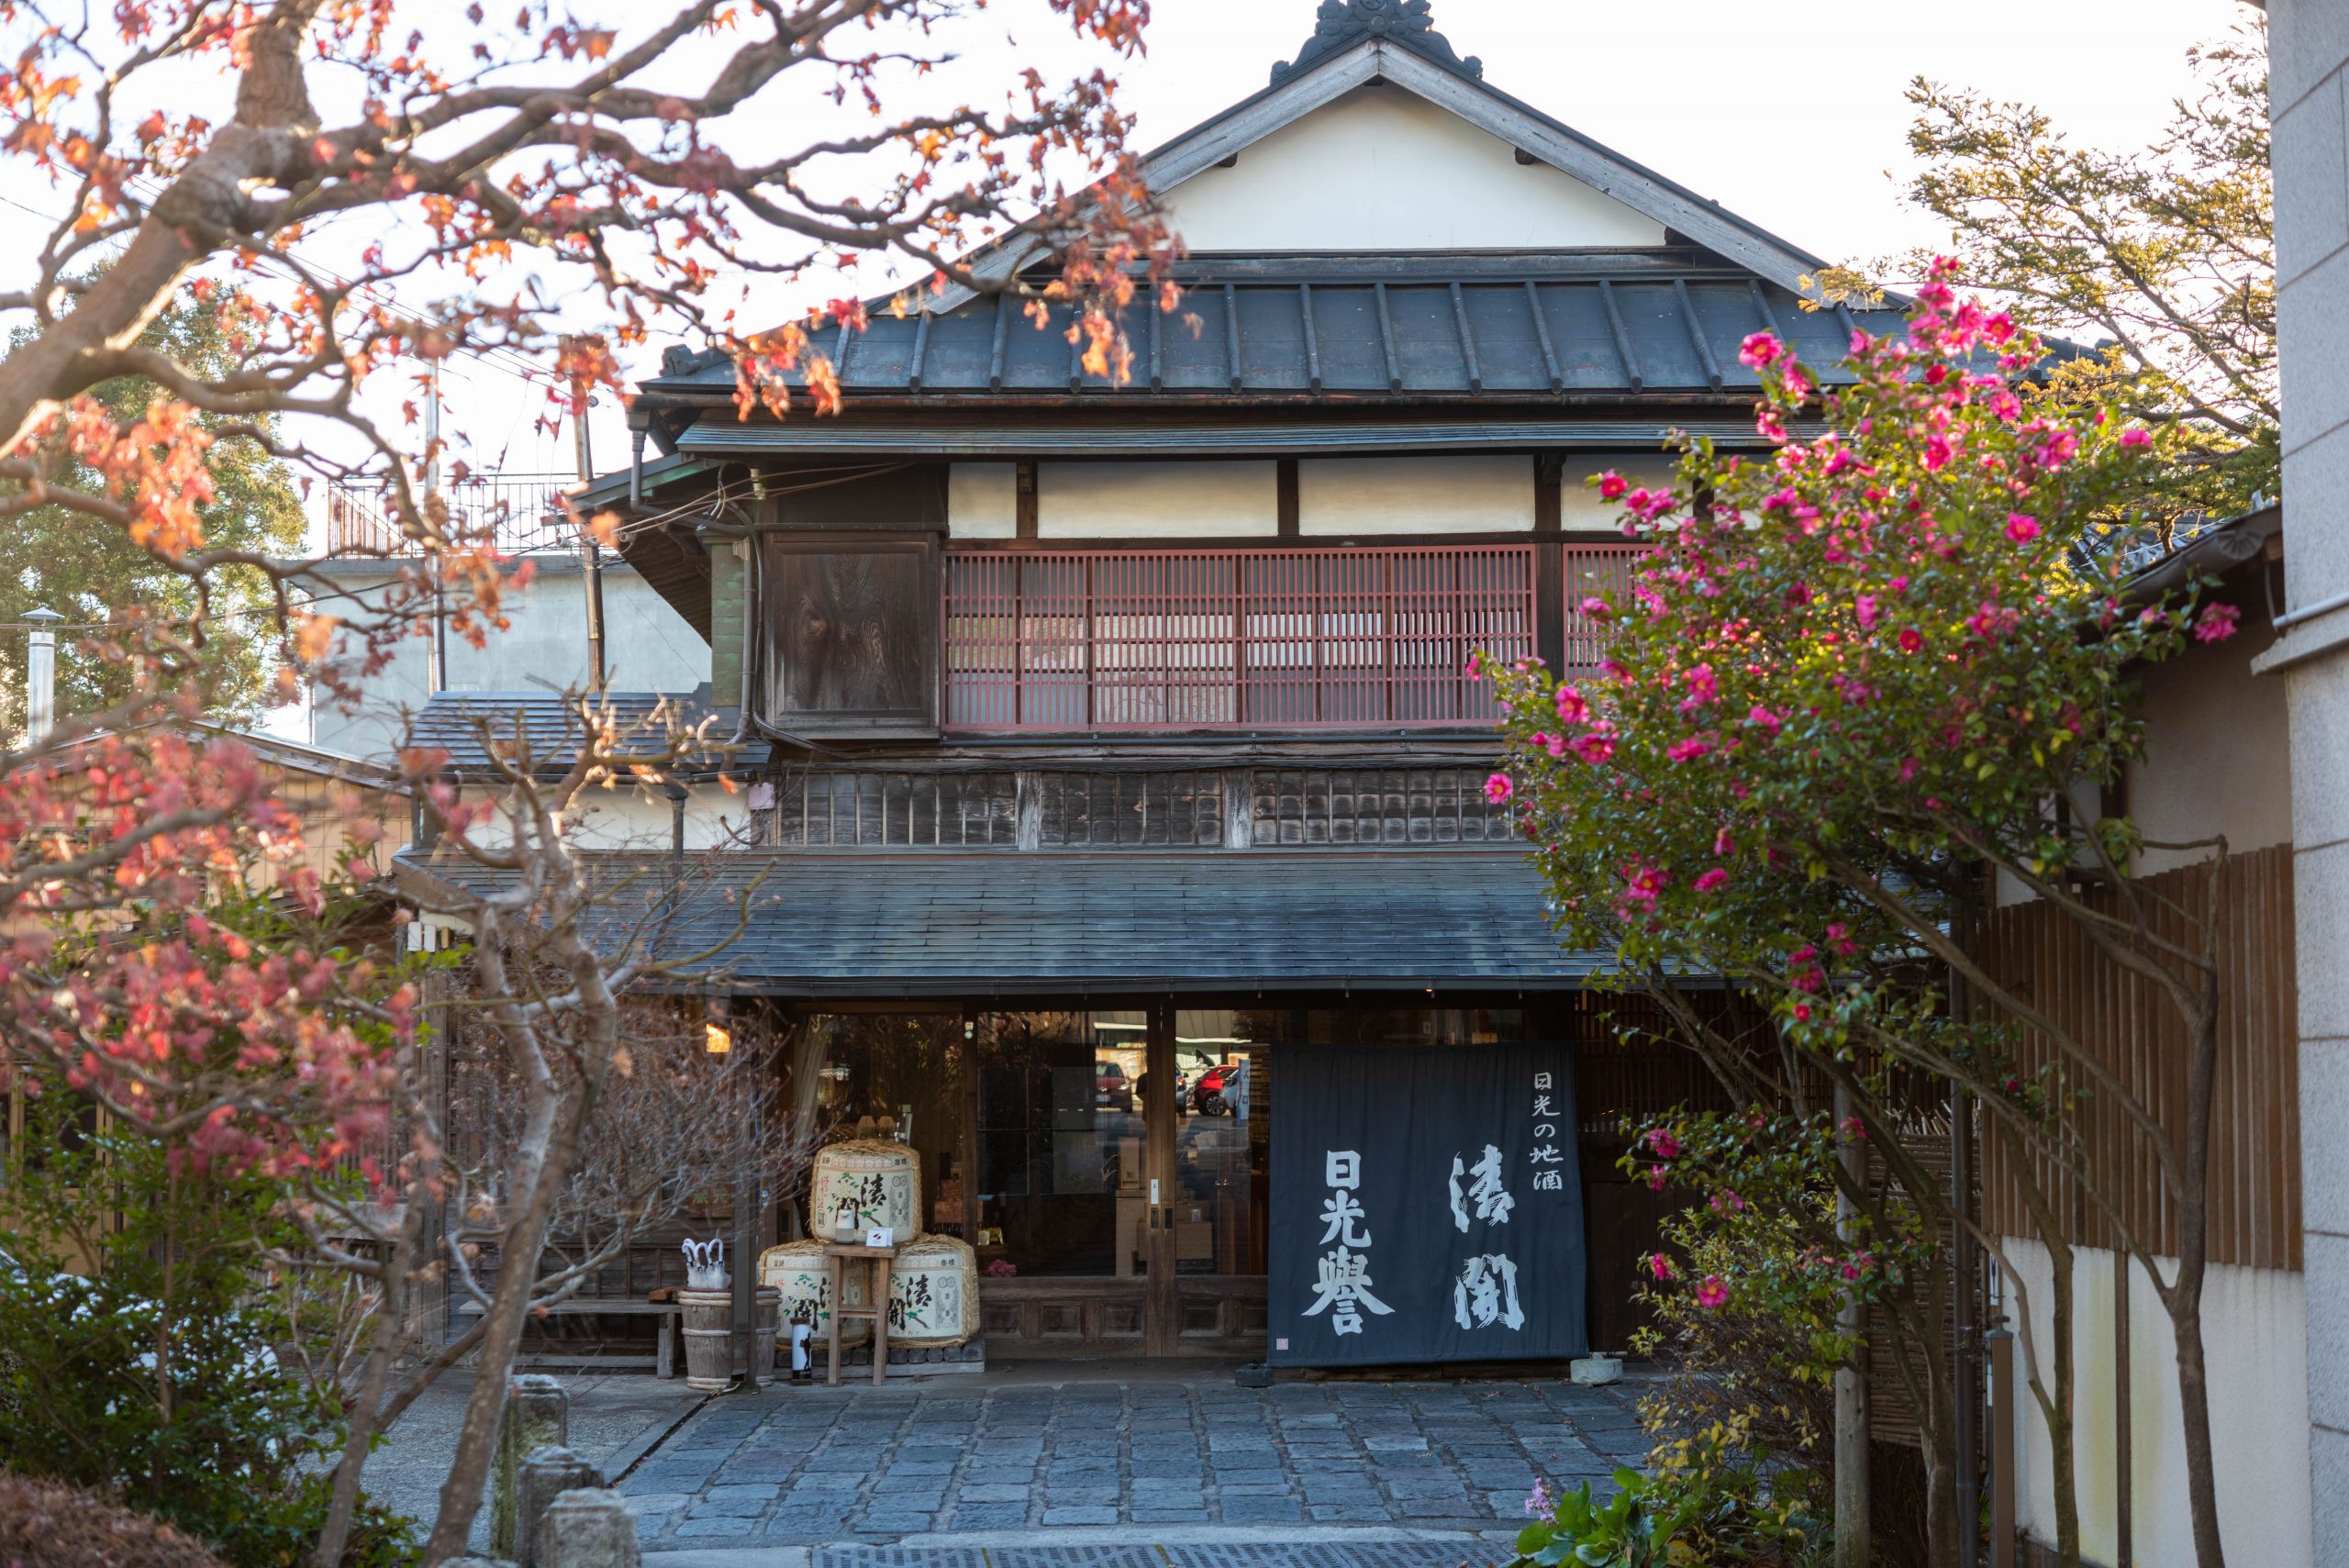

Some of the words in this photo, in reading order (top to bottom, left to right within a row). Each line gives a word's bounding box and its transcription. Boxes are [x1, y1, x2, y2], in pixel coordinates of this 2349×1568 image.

[1530, 1072, 1564, 1191] 日光の地酒
